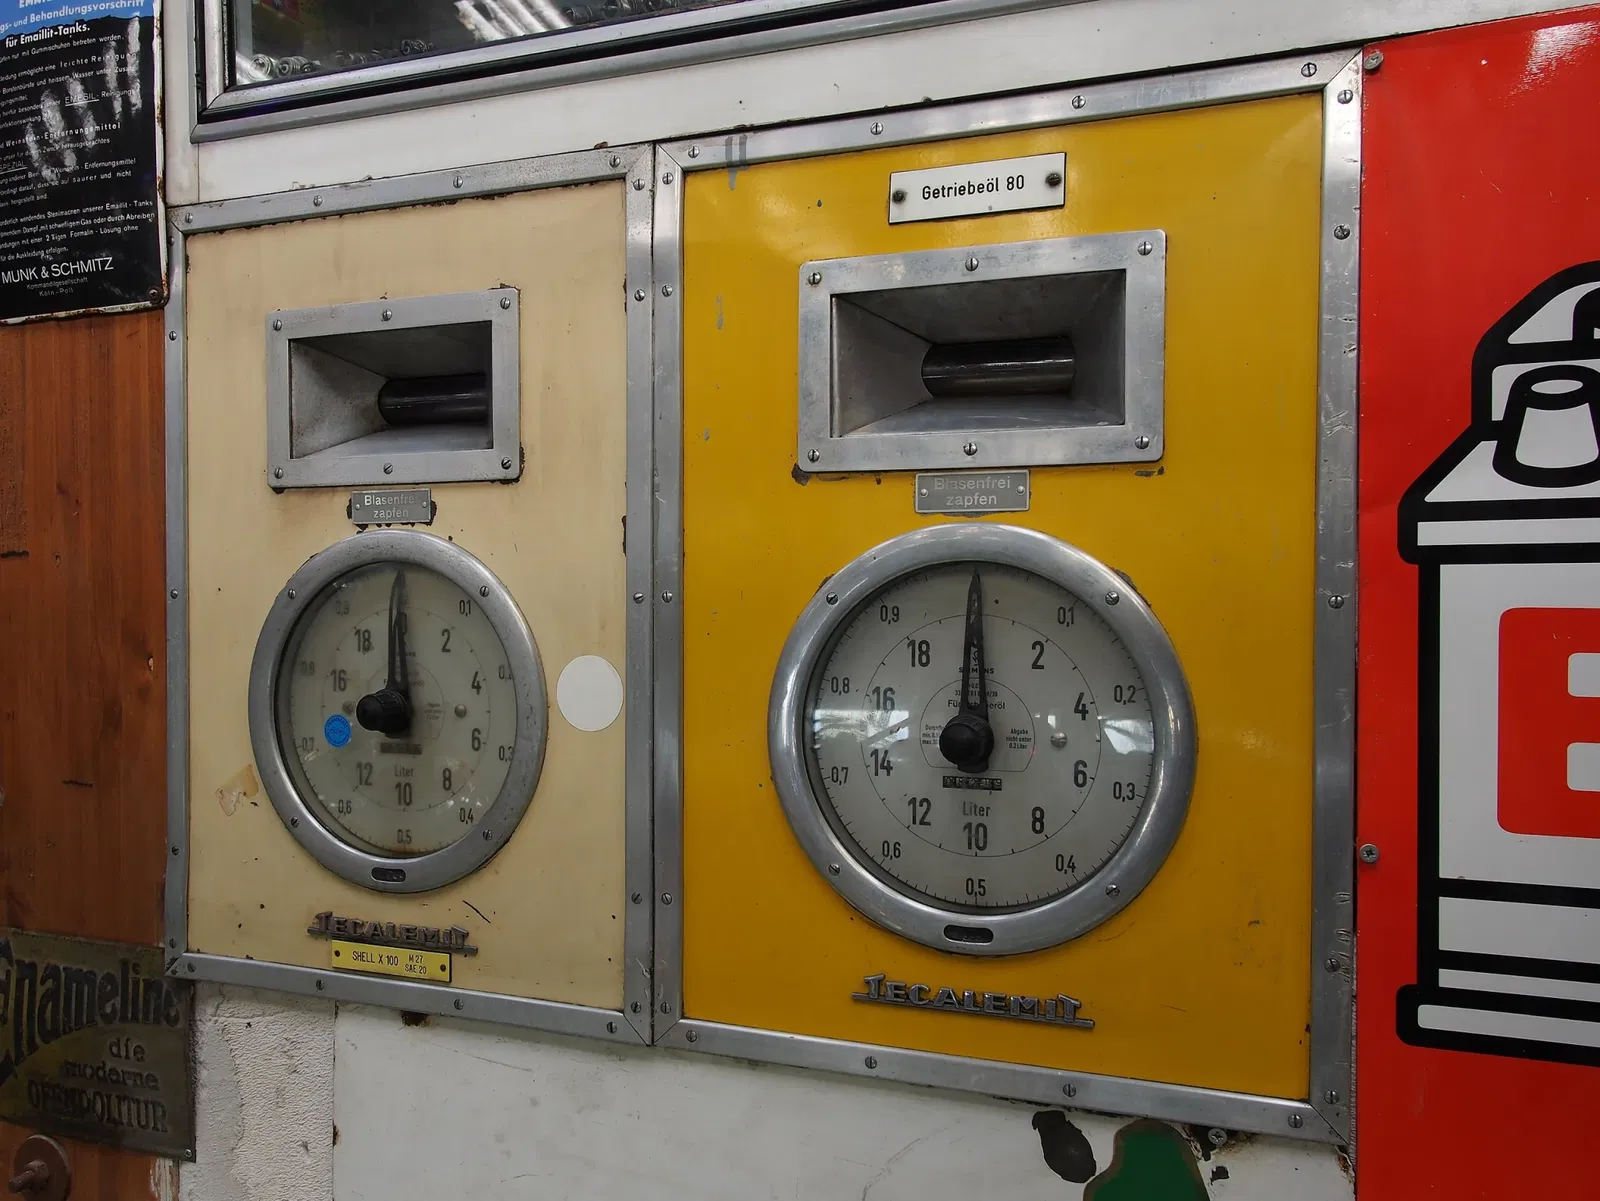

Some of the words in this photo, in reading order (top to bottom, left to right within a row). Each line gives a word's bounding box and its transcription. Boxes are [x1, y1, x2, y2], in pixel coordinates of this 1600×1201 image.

[13, 15, 28, 27] und
[30, 0, 144, 24] Behandlungsvorschrift
[5, 36, 18, 48] für
[20, 22, 91, 44] Emaillit-Tanks.
[60, 58, 89, 67] leichte
[72, 174, 97, 183] saurer
[100, 171, 112, 179] und
[116, 170, 132, 178] nicht
[922, 177, 999, 200] Getriebeöl
[1006, 174, 1024, 191] 80
[92, 216, 107, 224] oder
[107, 214, 125, 222] durch
[123, 224, 139, 232] ohne
[1, 267, 38, 284] MUNK
[40, 266, 49, 279] &
[50, 256, 115, 277] SCHMITZ
[934, 475, 1011, 490] Blasenfrei
[946, 492, 997, 508] zapfen
[373, 507, 409, 520] zapfen
[458, 599, 471, 617] 0,1
[880, 604, 900, 625] 0,9
[1057, 606, 1075, 627] 0,1
[354, 628, 372, 653] 18
[441, 628, 451, 653] 2
[906, 639, 931, 668] 18
[1031, 640, 1045, 670] 2
[330, 668, 348, 692] 16
[471, 671, 483, 695] 4
[831, 676, 850, 696] 0,8
[871, 685, 896, 711] 16
[1073, 691, 1089, 721] 4
[1113, 684, 1137, 706] 0,2
[472, 727, 481, 751] 6
[356, 762, 373, 786] 12
[394, 763, 414, 777] Liter
[870, 748, 893, 777] 14
[1073, 759, 1088, 788] 6
[442, 767, 452, 791] 8
[831, 766, 849, 786] 0,7
[394, 781, 413, 807] 10
[1112, 781, 1136, 802] 0,3
[338, 799, 352, 815] 0,6
[459, 807, 474, 824] 0,4
[907, 796, 932, 826] 12
[962, 801, 991, 817] Liter
[1031, 806, 1045, 835] 8
[396, 828, 412, 845] 0,5
[962, 821, 988, 851] 10
[881, 840, 901, 860] 0,6
[1055, 853, 1076, 875] 0,4
[965, 877, 986, 897] 0,5
[314, 911, 470, 949] TECALEMIT
[352, 950, 376, 964] SHELL
[378, 954, 385, 965] X
[386, 956, 399, 967] 100
[404, 963, 417, 974] SAE
[418, 965, 427, 975] 20
[408, 954, 414, 963] M
[415, 954, 424, 964] 27
[863, 973, 1082, 1022] TECALEMIT
[109, 1037, 146, 1062] die
[60, 1060, 160, 1091] moderne
